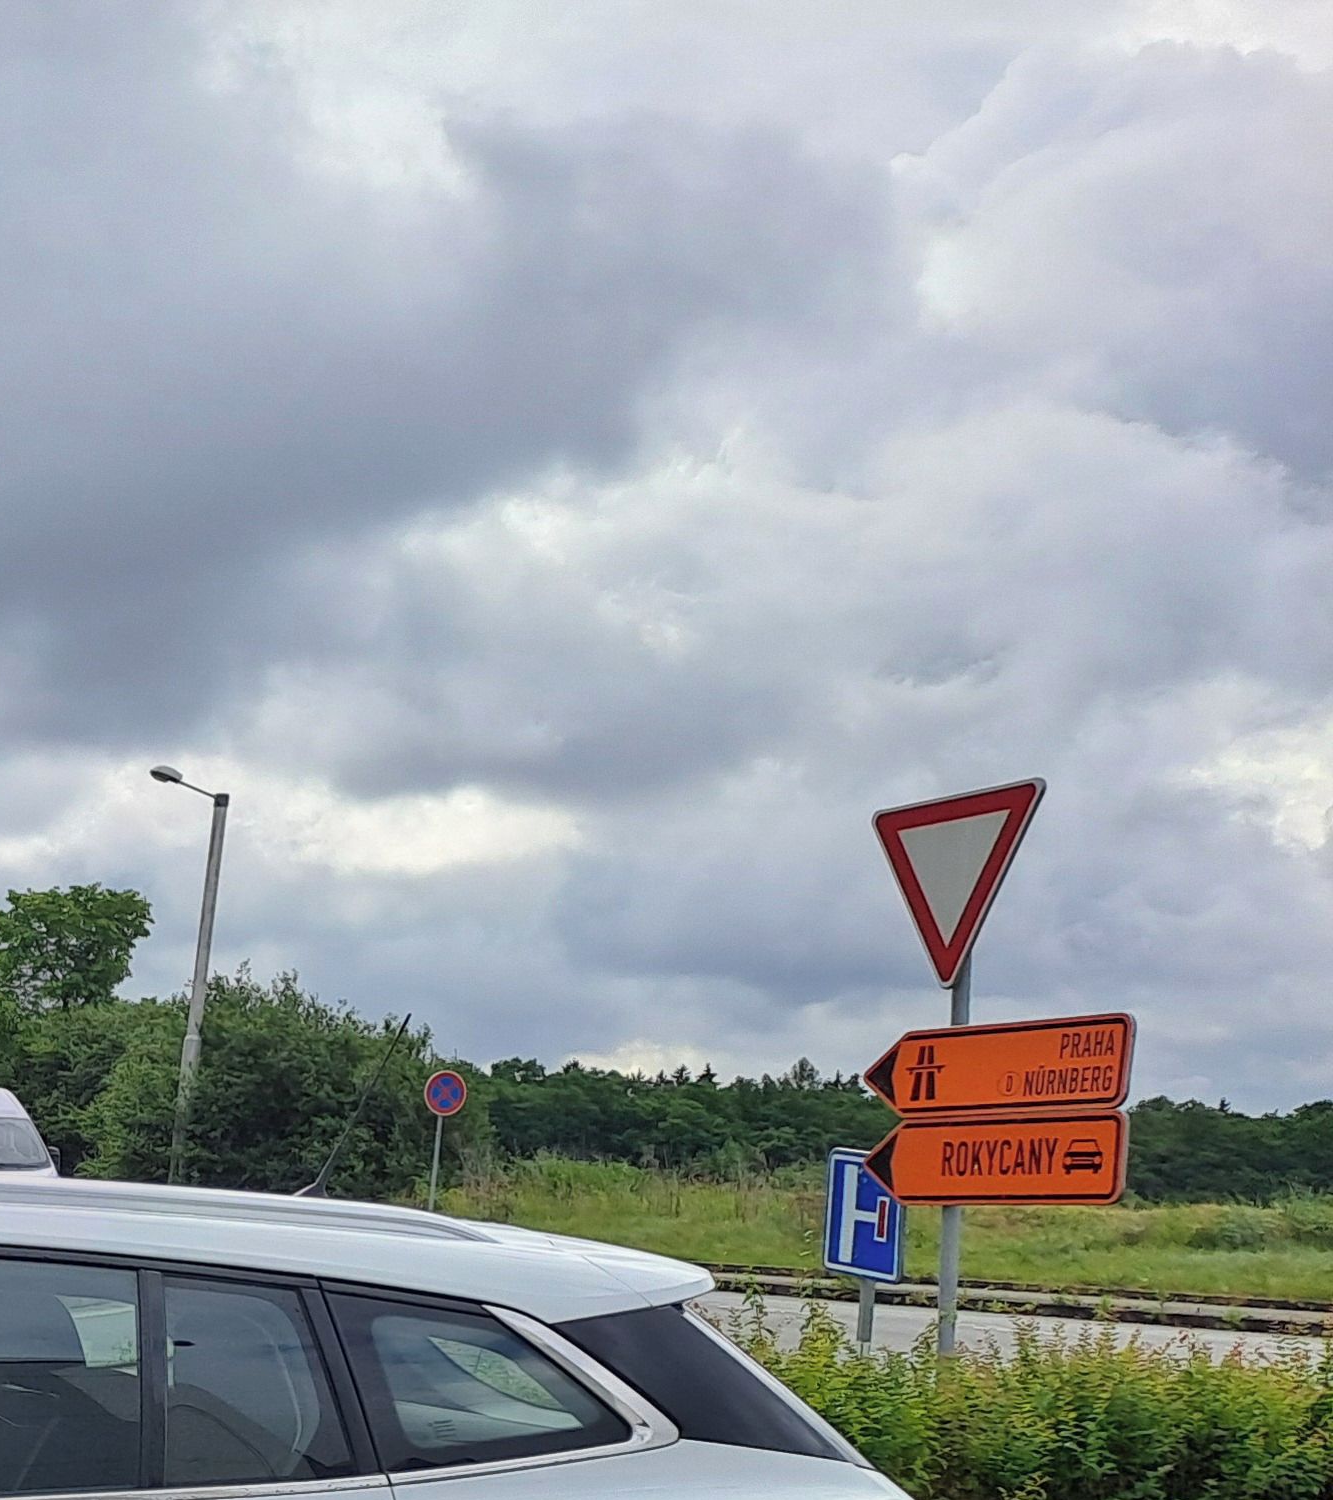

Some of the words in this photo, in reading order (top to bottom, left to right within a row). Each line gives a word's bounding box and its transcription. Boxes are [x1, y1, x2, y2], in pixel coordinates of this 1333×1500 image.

[1059, 1030, 1115, 1060] PRAHA
[1005, 1075, 1014, 1092] D
[1023, 1065, 1114, 1096] NÜRNBERG
[941, 1138, 1059, 1176] ROKYCANY
